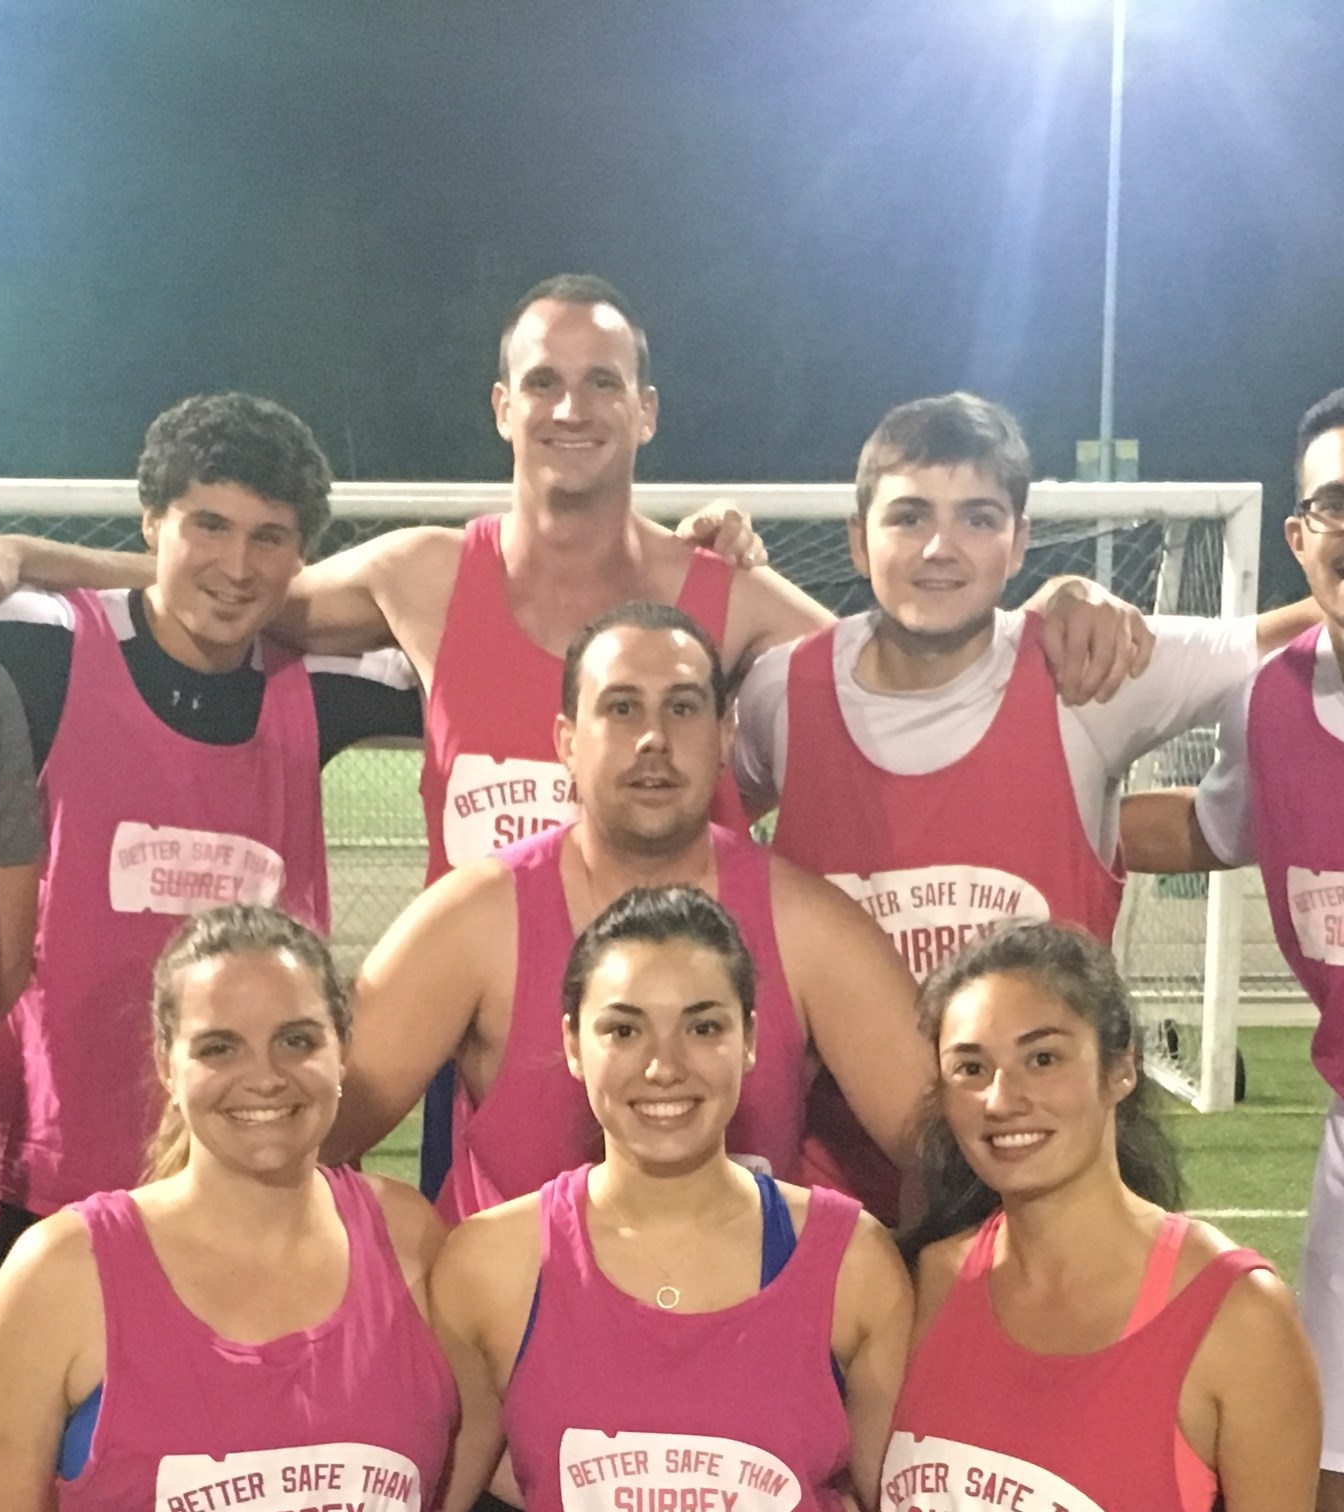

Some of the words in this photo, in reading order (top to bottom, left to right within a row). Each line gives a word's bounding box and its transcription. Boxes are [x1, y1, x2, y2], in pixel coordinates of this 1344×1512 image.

[454, 779, 537, 818] BETTER
[553, 779, 584, 804] SA
[118, 840, 180, 869] BETTER
[192, 842, 234, 866] SAFE
[150, 867, 244, 901] SURREY
[865, 890, 901, 919] TER
[910, 882, 957, 909] SAFE
[969, 883, 1022, 915] THAN
[282, 1464, 345, 1493] SAFE
[362, 1465, 413, 1503] THAN
[567, 1450, 649, 1488] BETTER
[665, 1449, 724, 1477] SAFE
[737, 1460, 789, 1497] THAN
[886, 1463, 949, 1506] BETTER
